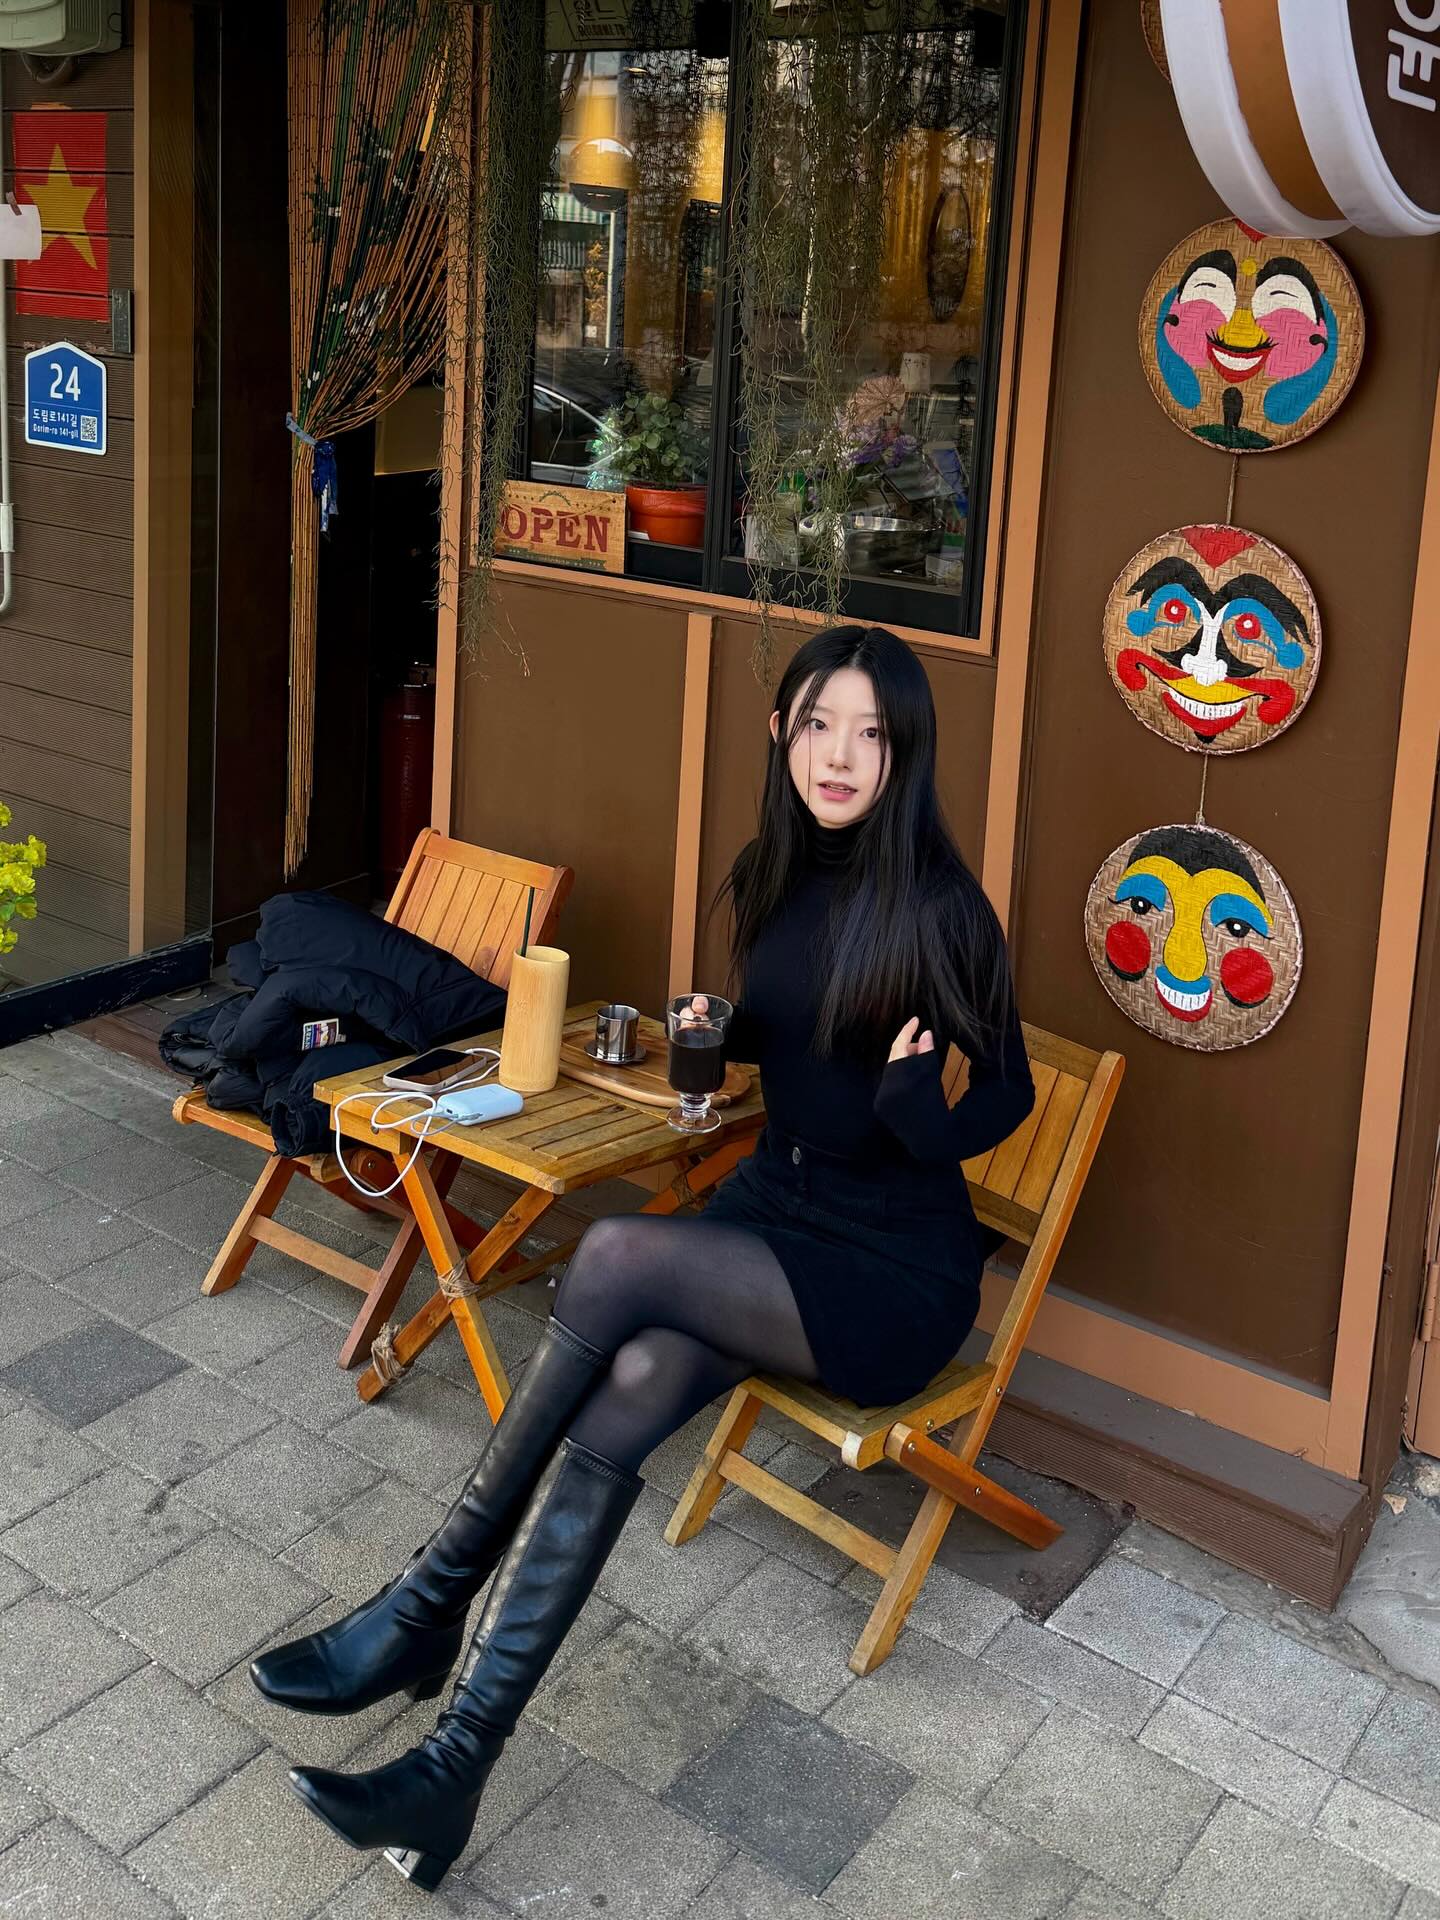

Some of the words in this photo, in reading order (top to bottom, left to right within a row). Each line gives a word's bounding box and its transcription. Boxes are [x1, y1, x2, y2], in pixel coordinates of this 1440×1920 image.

[49, 362, 81, 402] 24
[32, 408, 78, 428] 도림로141길
[33, 423, 58, 435] Dorim-ro
[59, 427, 79, 439] 141-gil
[501, 503, 611, 553] OPEN
